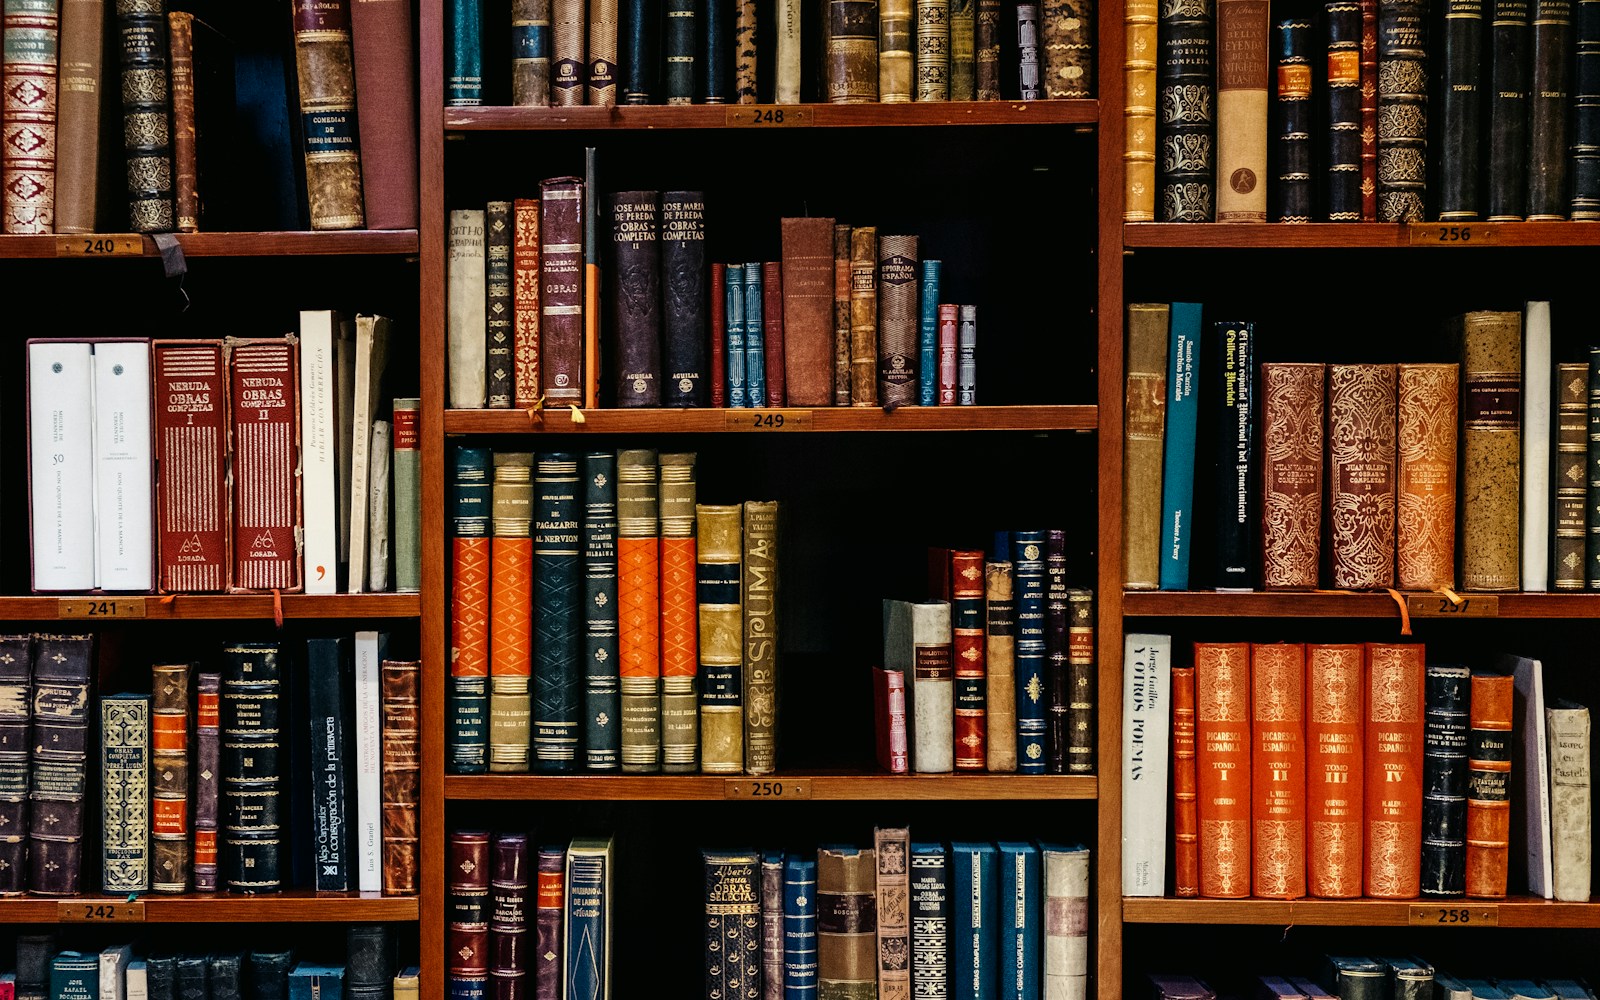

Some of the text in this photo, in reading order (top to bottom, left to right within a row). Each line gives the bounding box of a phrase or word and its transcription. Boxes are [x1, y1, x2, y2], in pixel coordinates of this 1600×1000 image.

[1227, 31, 1262, 39] BELLAS
[312, 116, 346, 124] COMEDIAS
[753, 109, 784, 123] 248
[612, 203, 656, 212] JOSE MARIA
[662, 202, 705, 211] JOSE MARIA
[614, 212, 655, 221] DE PEREDA
[664, 211, 703, 220] DE PEREDA
[620, 222, 649, 232] OBRAS
[669, 221, 697, 230] OBRAS
[613, 232, 656, 242] COMPLETAS
[662, 231, 705, 240] COMPLETAS
[1439, 227, 1471, 241] 256
[84, 239, 114, 254] 240
[881, 271, 914, 280] ESPAÑOL
[546, 284, 578, 293] OBRAS
[1237, 329, 1248, 341] El
[1238, 341, 1248, 367] teatro
[1174, 334, 1186, 401] Proverbios Morales
[1184, 340, 1193, 396] Santob de Carrión
[1224, 329, 1236, 407] Edilberto Marbán
[169, 382, 211, 391] NERUDA
[242, 377, 284, 388] NERUDA
[1236, 368, 1247, 400] español
[169, 393, 210, 405] OBRAS
[242, 389, 283, 400] OBRAS
[167, 403, 214, 412] COMPLETAS
[240, 399, 287, 408] COMPLETAS
[187, 414, 194, 424] I
[258, 410, 270, 420] II
[317, 407, 325, 424] CON
[753, 413, 785, 427] 249
[1237, 403, 1248, 441] Medieval
[53, 453, 64, 466] 50
[1238, 450, 1248, 463] del
[1237, 464, 1248, 523] Renacimiento
[536, 521, 578, 530] PAGAZARRI
[1174, 509, 1182, 536] Theodore
[535, 535, 578, 543] AL NERVION
[1173, 536, 1181, 544] A.
[249, 550, 278, 558] LOSADA
[1049, 567, 1066, 575] COPLAS
[88, 601, 117, 615] 241
[748, 538, 776, 684] ESPUMA
[1147, 647, 1159, 709] Jorge Guillén
[1131, 647, 1146, 781] Y OTROS POEMAS
[1206, 731, 1241, 741] PICARESCA
[1262, 731, 1297, 741] PICARESCA
[1319, 732, 1354, 743] PICARESCA
[1378, 732, 1412, 742] PICARESCA
[1206, 742, 1241, 752] ESPAÑOLA
[1262, 742, 1296, 752] ESPAÑOLA
[1319, 743, 1353, 753] ESPAÑOLA
[1378, 743, 1411, 752] ESPAÑOLA
[1220, 770, 1228, 781] I
[1272, 770, 1288, 781] II
[1324, 772, 1349, 783] III
[1385, 771, 1405, 782] IV
[324, 716, 341, 863] La consagración de la primavera
[752, 783, 783, 796] 250
[1325, 799, 1348, 807] QUEVEDO
[318, 804, 329, 863] Alejo Carpentier
[366, 821, 375, 847] Granjel
[714, 865, 752, 876] Alberto
[1141, 860, 1149, 887] Muchnik
[719, 875, 748, 884] Insua
[714, 883, 752, 893] OBRAS
[912, 882, 930, 890] VARGAS
[573, 898, 601, 906] DE LARRA
[709, 892, 757, 902] SELECTAS
[85, 905, 116, 918] 242
[1438, 909, 1470, 923] 258
